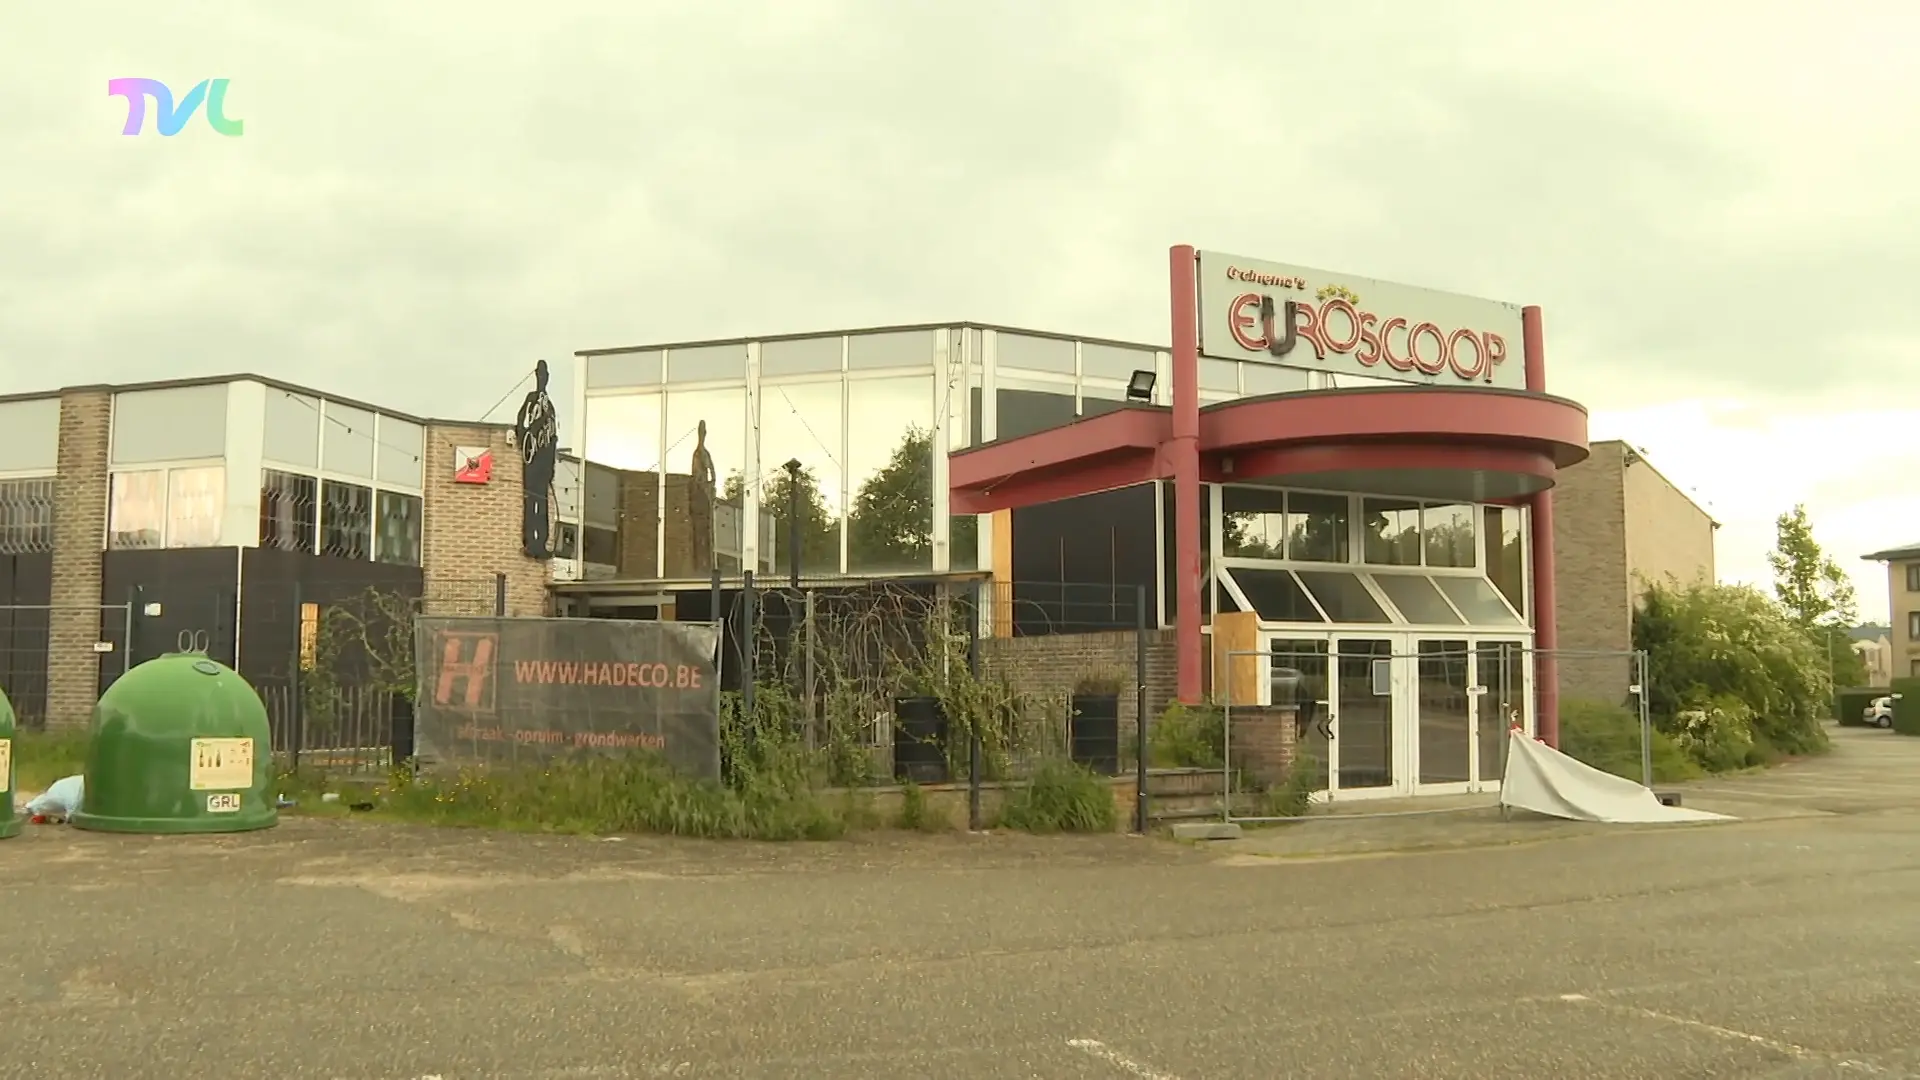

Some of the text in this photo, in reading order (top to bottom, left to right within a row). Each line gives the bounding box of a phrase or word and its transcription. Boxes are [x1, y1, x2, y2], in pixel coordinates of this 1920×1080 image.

[1230, 293, 1506, 383] EUROSCOOP
[514, 660, 701, 688] WWW.HADECO.BE
[515, 729, 564, 744] opruim
[574, 730, 665, 749] grondwerken
[209, 795, 239, 809] GRL
